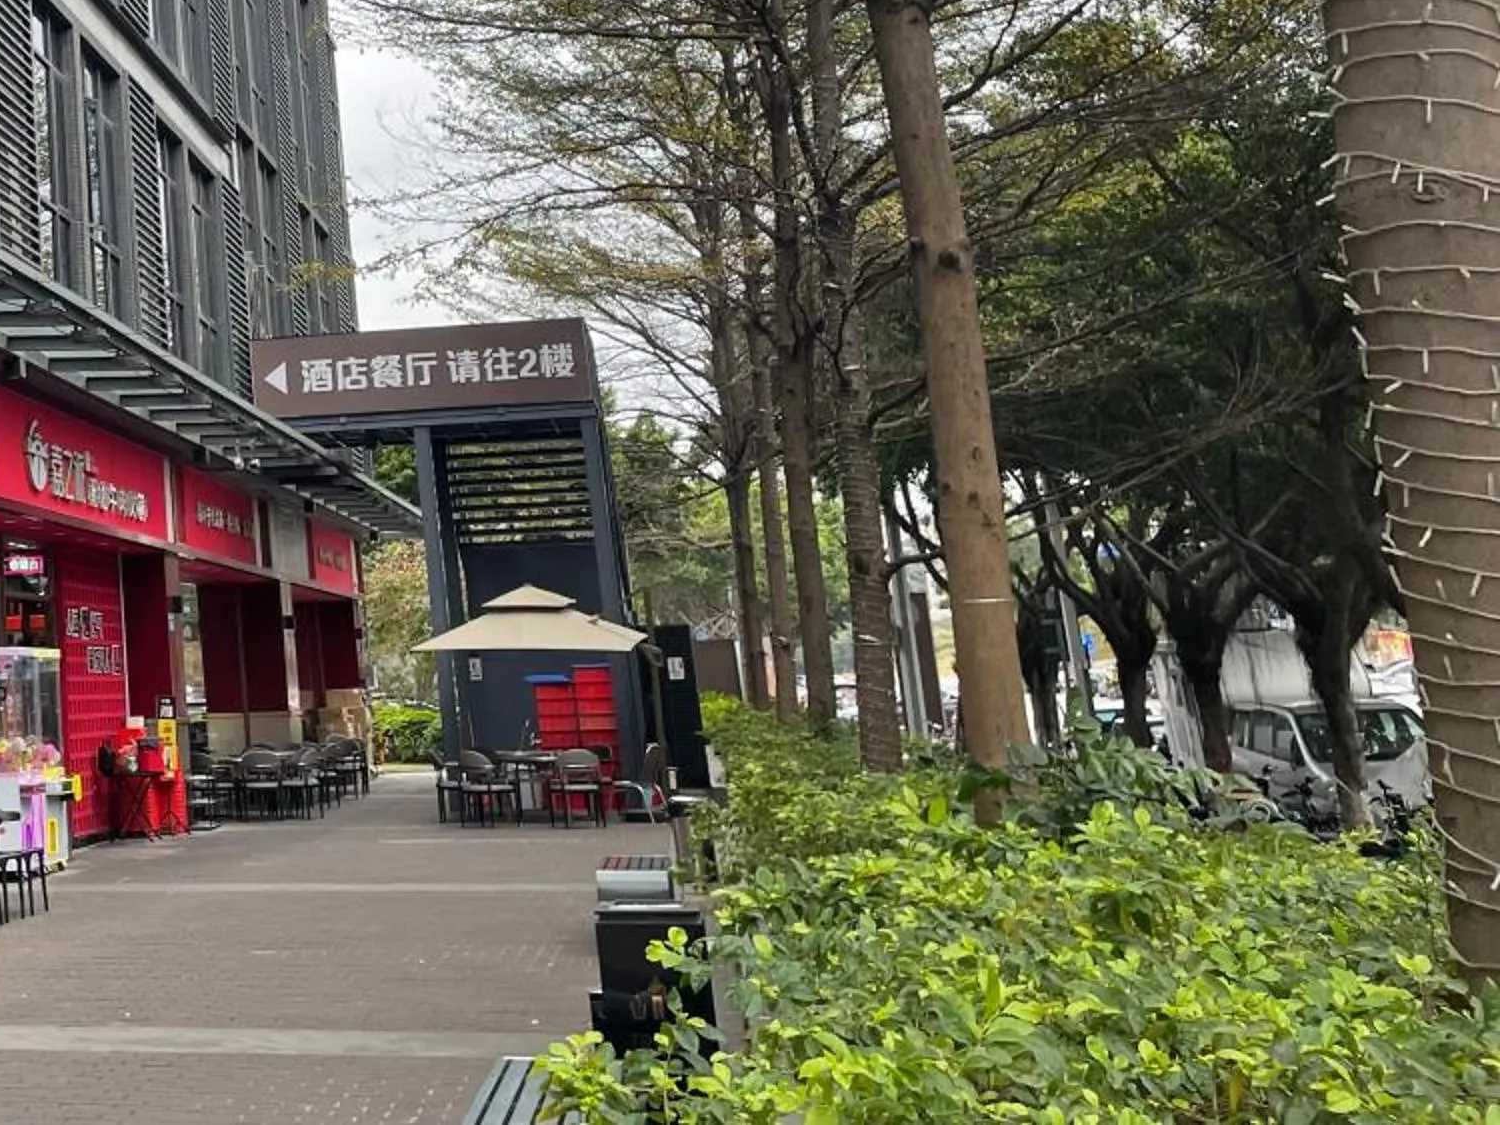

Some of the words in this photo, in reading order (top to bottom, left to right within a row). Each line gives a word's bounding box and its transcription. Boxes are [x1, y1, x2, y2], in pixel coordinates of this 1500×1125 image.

[301, 352, 438, 394] 酒店餐厅
[446, 342, 575, 385] 请往2楼
